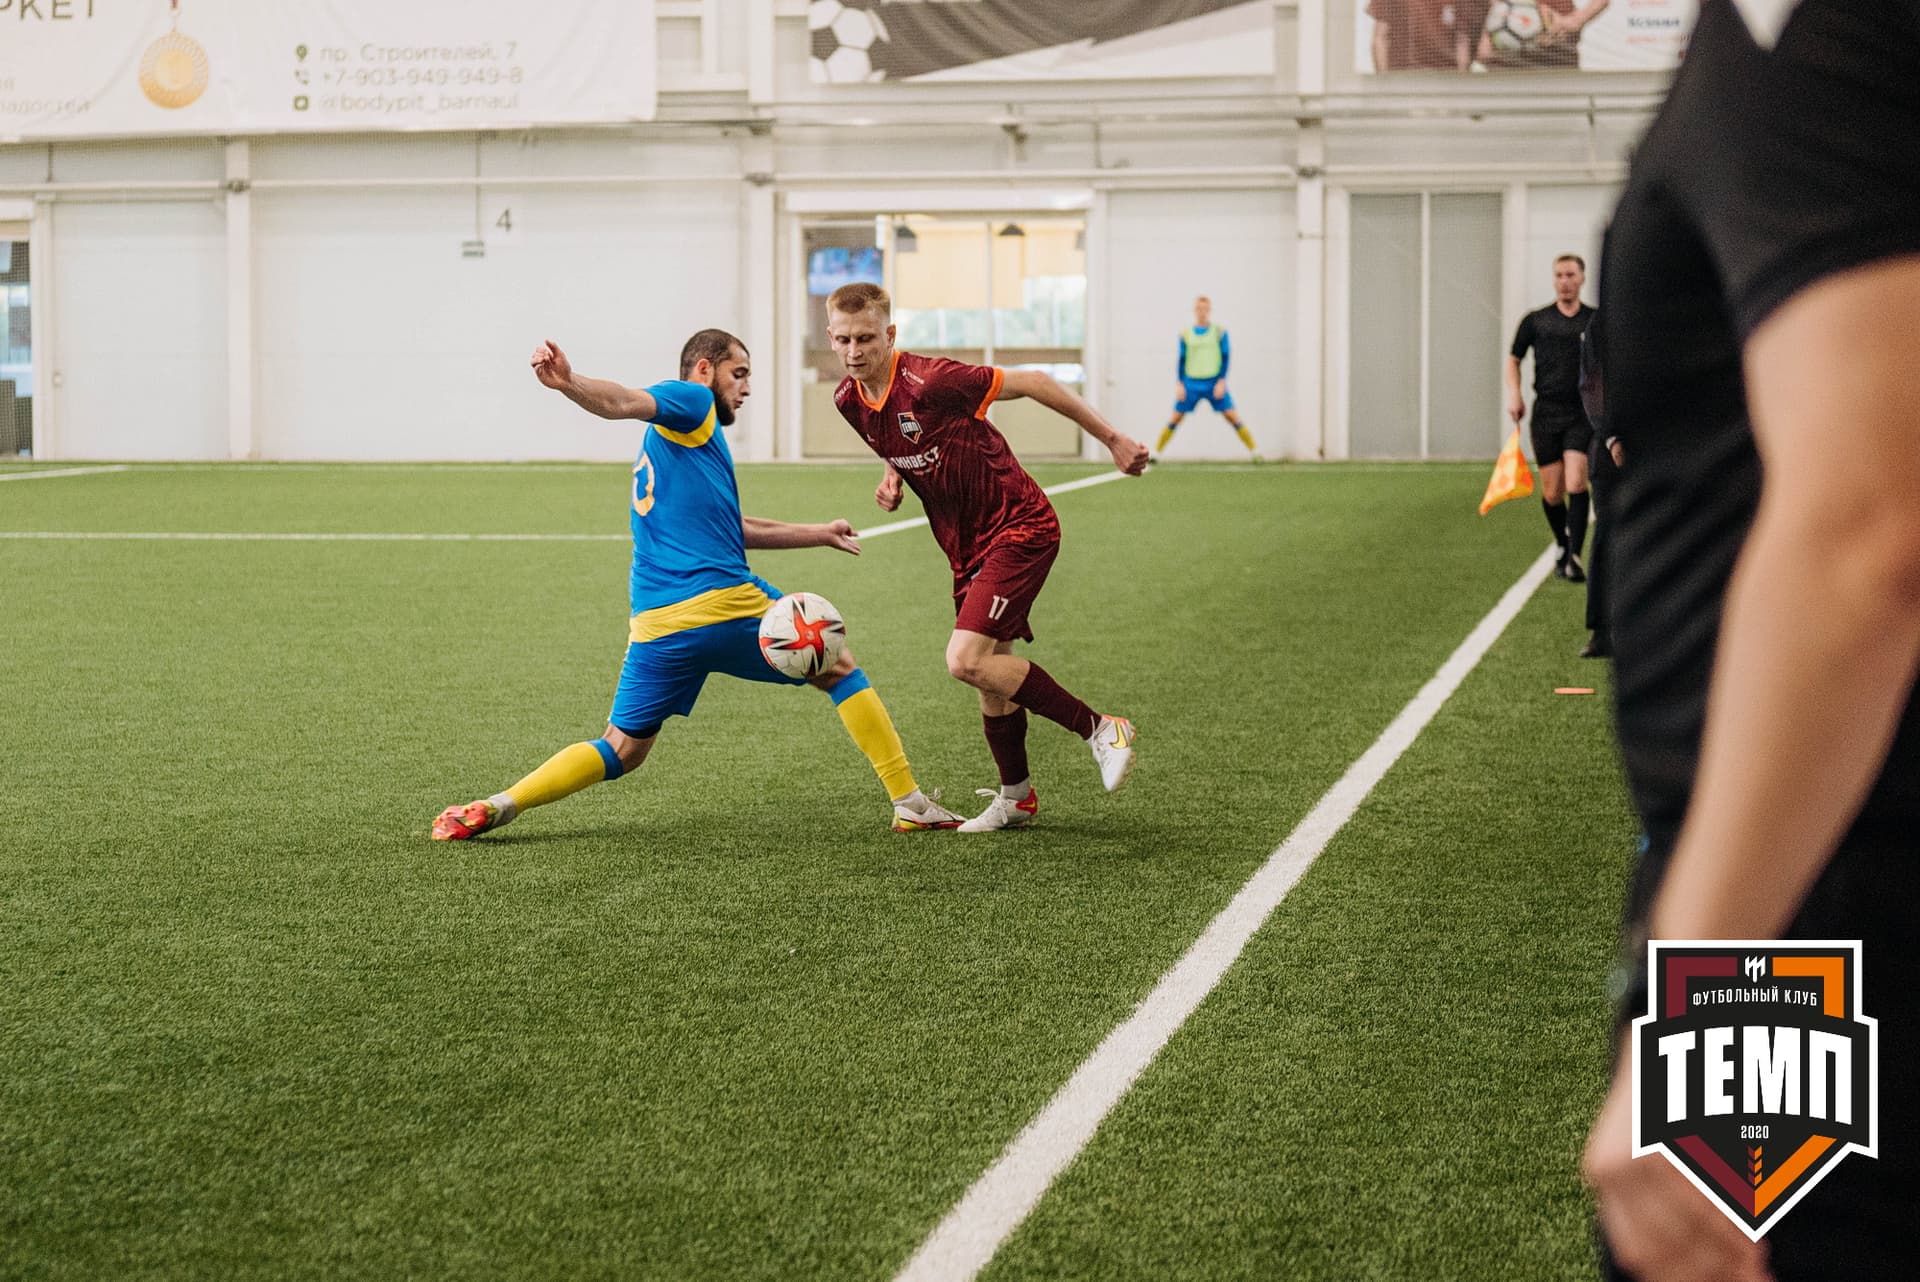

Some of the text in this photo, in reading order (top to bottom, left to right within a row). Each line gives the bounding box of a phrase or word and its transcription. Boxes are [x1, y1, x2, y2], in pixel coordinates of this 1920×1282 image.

[505, 40, 518, 59] 7
[323, 66, 523, 86] +7-903-949-949-8
[495, 209, 512, 233] 4
[988, 595, 1009, 620] 17
